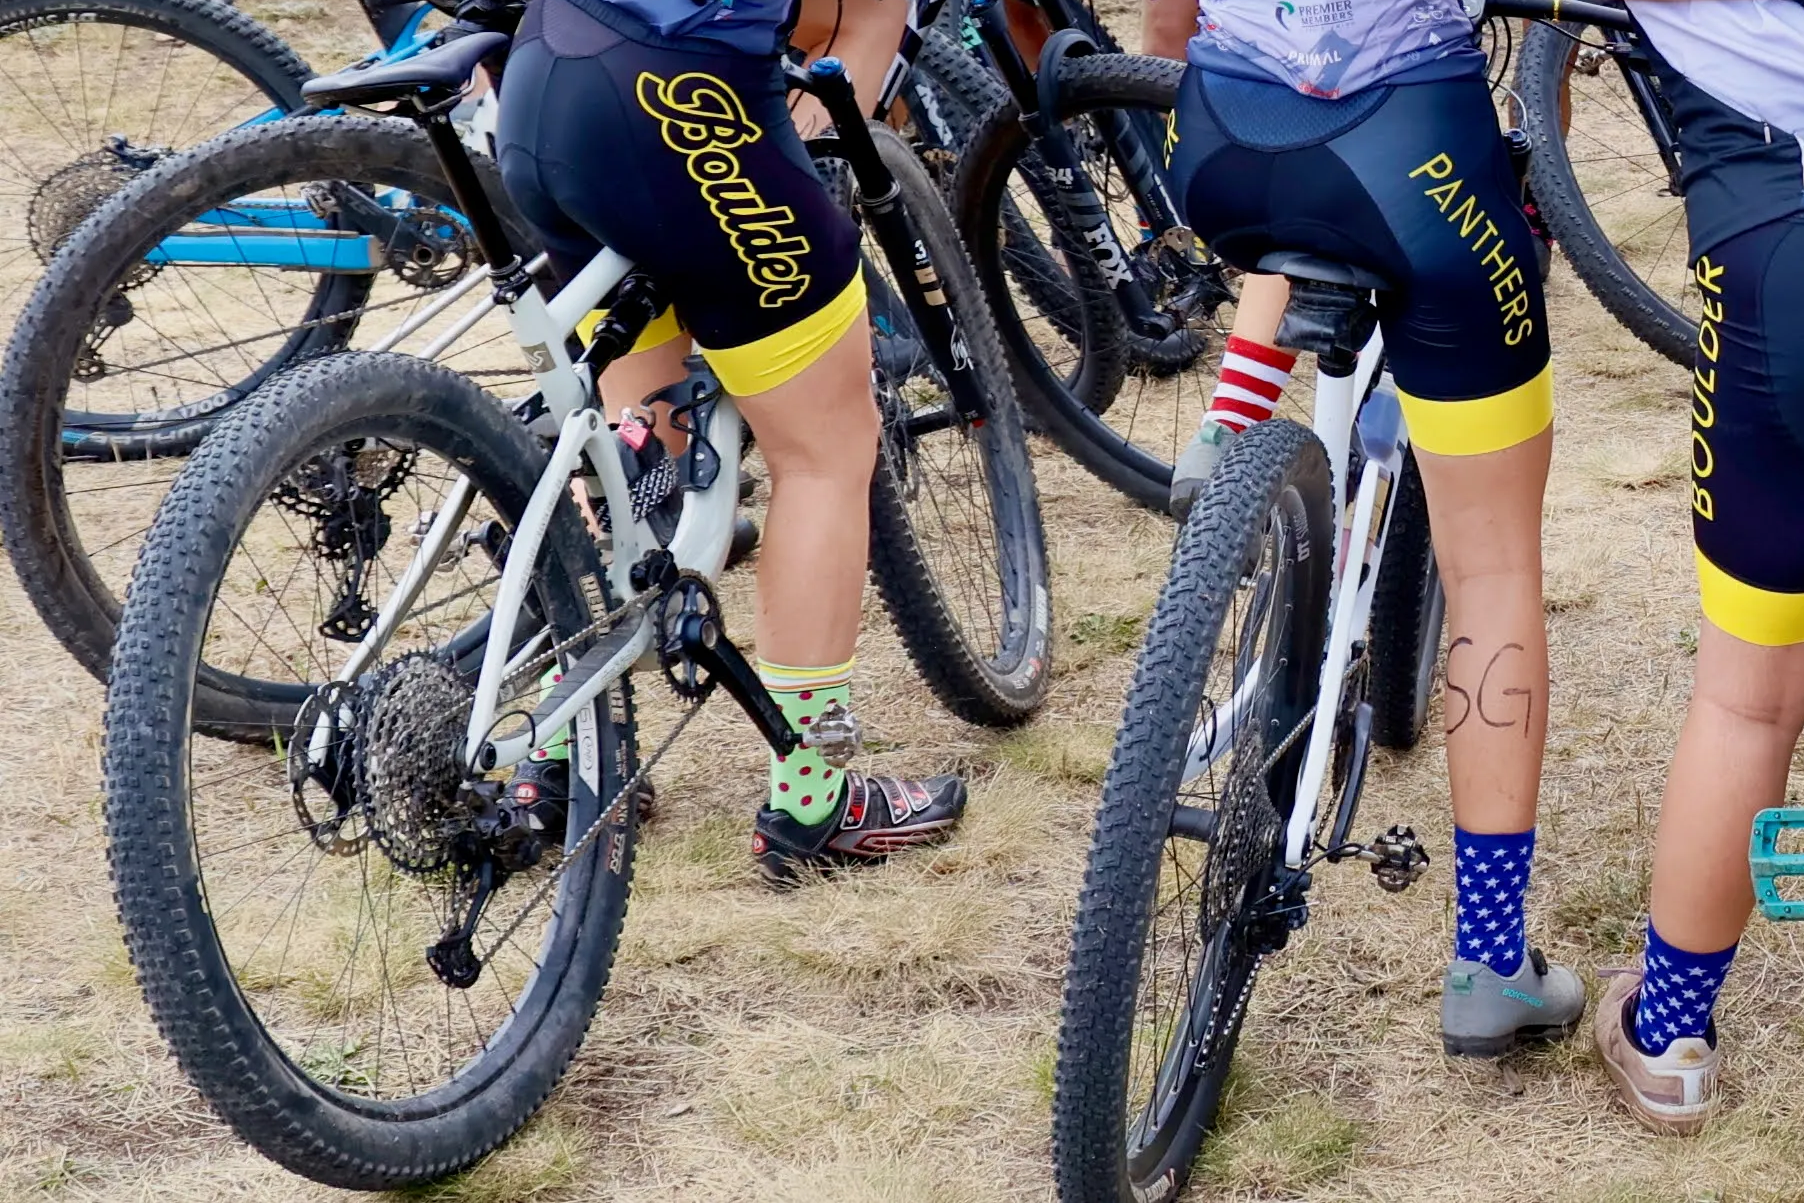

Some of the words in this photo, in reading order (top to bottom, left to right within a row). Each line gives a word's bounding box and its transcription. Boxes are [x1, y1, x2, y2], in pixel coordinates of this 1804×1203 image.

[1298, 0, 1353, 17] PREMIER
[1300, 10, 1355, 25] MEMBERS
[1288, 50, 1342, 67] PRIMAL
[636, 71, 811, 308] Boulder
[1082, 221, 1135, 291] FOX
[1407, 152, 1533, 346] PANTHERS
[1691, 255, 1725, 522] BOULDER
